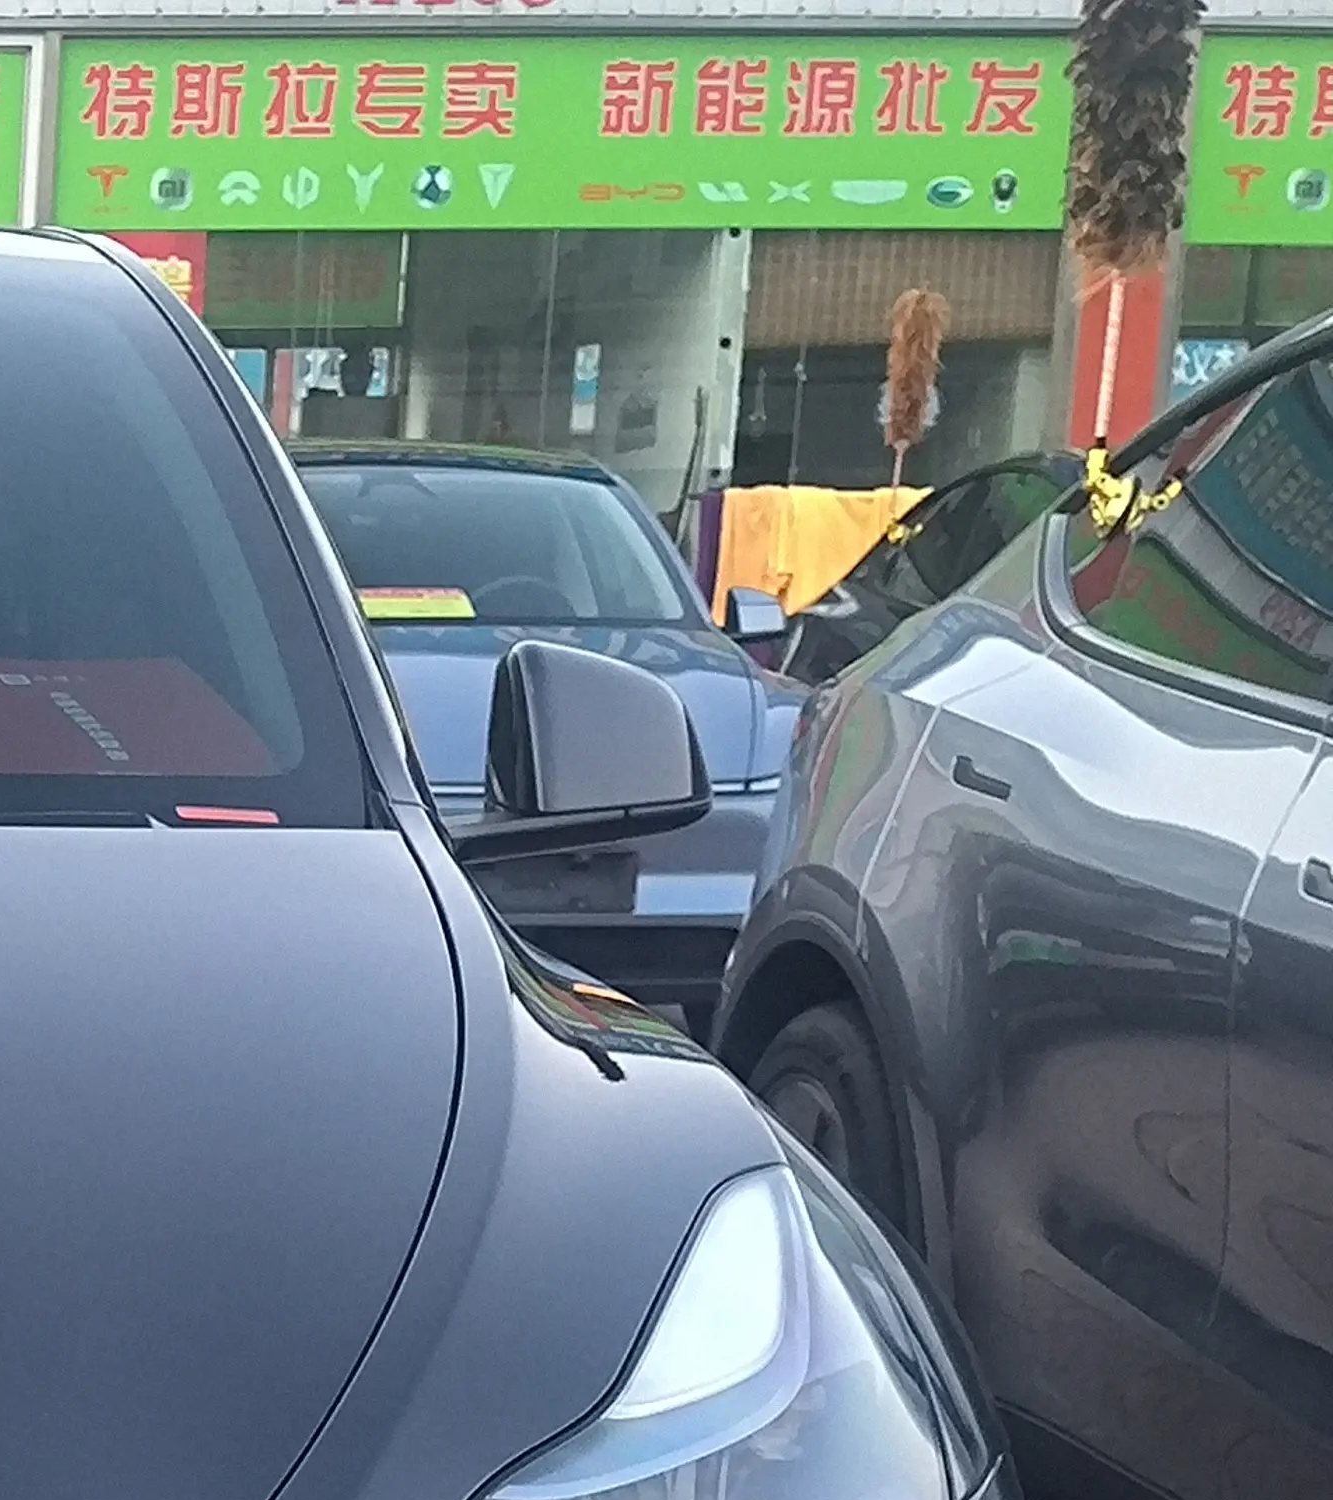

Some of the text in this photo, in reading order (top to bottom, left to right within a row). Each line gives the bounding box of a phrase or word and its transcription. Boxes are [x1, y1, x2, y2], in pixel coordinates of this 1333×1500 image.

[82, 56, 1044, 139] 特斯拉专卖 新能源批发
